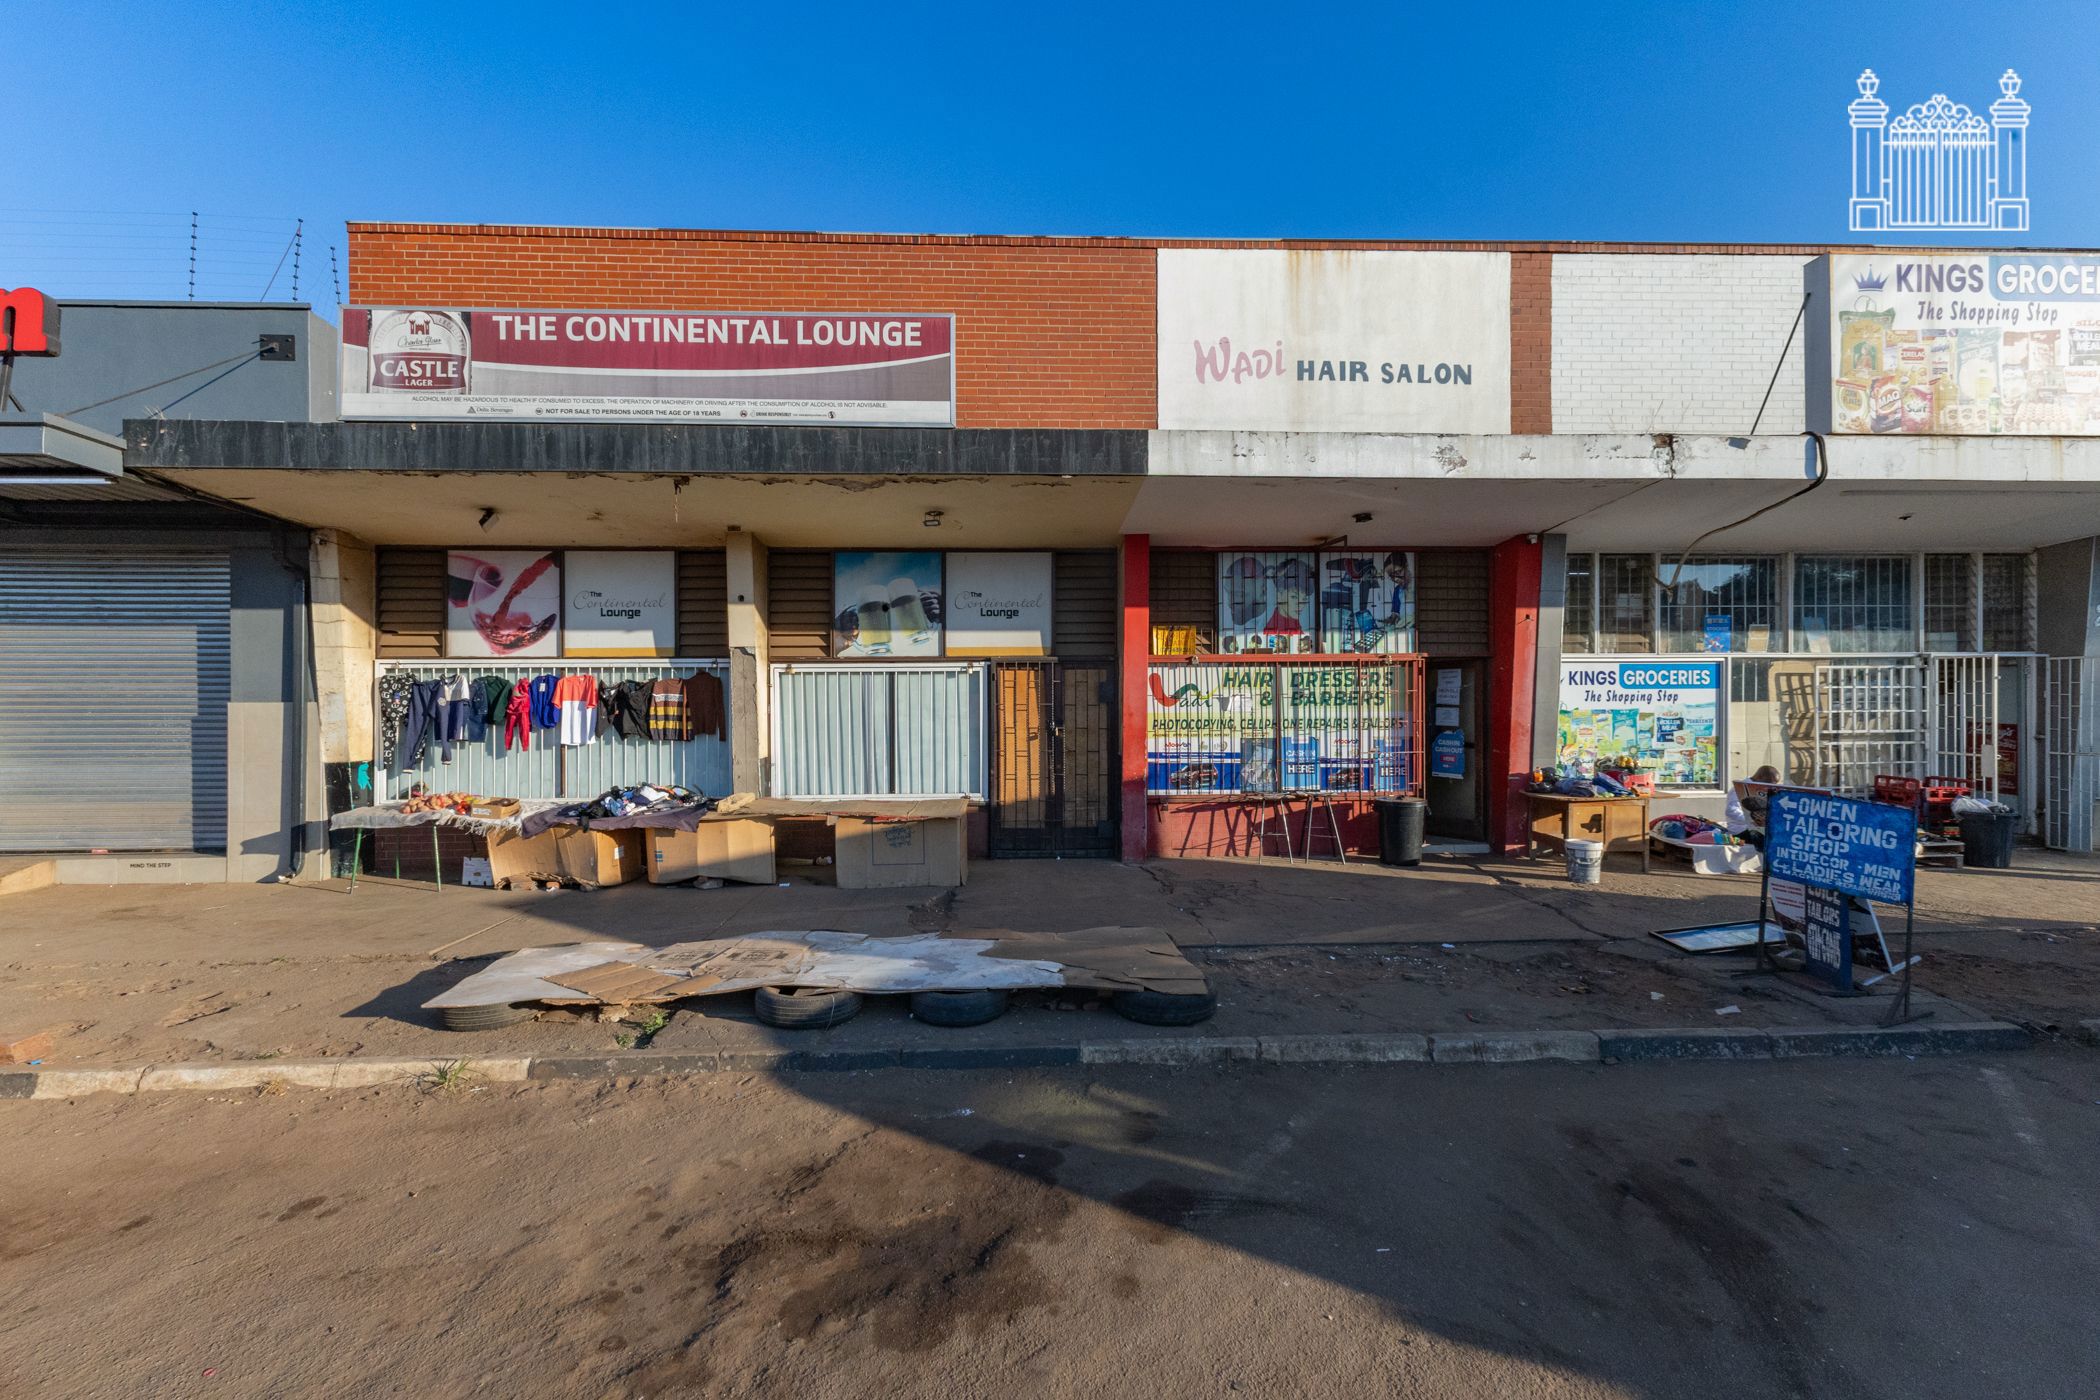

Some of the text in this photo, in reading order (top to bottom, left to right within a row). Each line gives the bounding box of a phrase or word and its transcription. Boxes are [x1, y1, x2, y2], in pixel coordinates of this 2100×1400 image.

[1896, 263, 2100, 295] KINGS GROCE
[1917, 300, 2058, 325] The Shopping Stop
[492, 315, 922, 346] THE CONTINENTAL LOUNGE
[380, 360, 459, 378] CASTLE
[1297, 360, 1369, 382] HAIR
[1381, 362, 1472, 386] SALON
[405, 379, 433, 387] LAGER
[760, 400, 800, 408] CONSUMPTION
[572, 590, 667, 610] Continental
[954, 590, 1043, 610] Continental
[600, 608, 641, 619] Lounge
[980, 608, 1020, 619] Lounge
[1223, 672, 1394, 688] HAIR DRESSERS
[1568, 670, 1711, 686] KINGS GROCERIES
[1260, 690, 1386, 706] & BARBERS
[1584, 690, 1679, 704] The Shopping Stop
[1288, 764, 1314, 774] HERE
[1800, 798, 1857, 822] OWEN
[1782, 814, 1898, 849] TAILORING
[1791, 834, 1850, 856] SHOP
[1793, 861, 1855, 886] LADIES
[1859, 875, 1901, 893] WEAR
